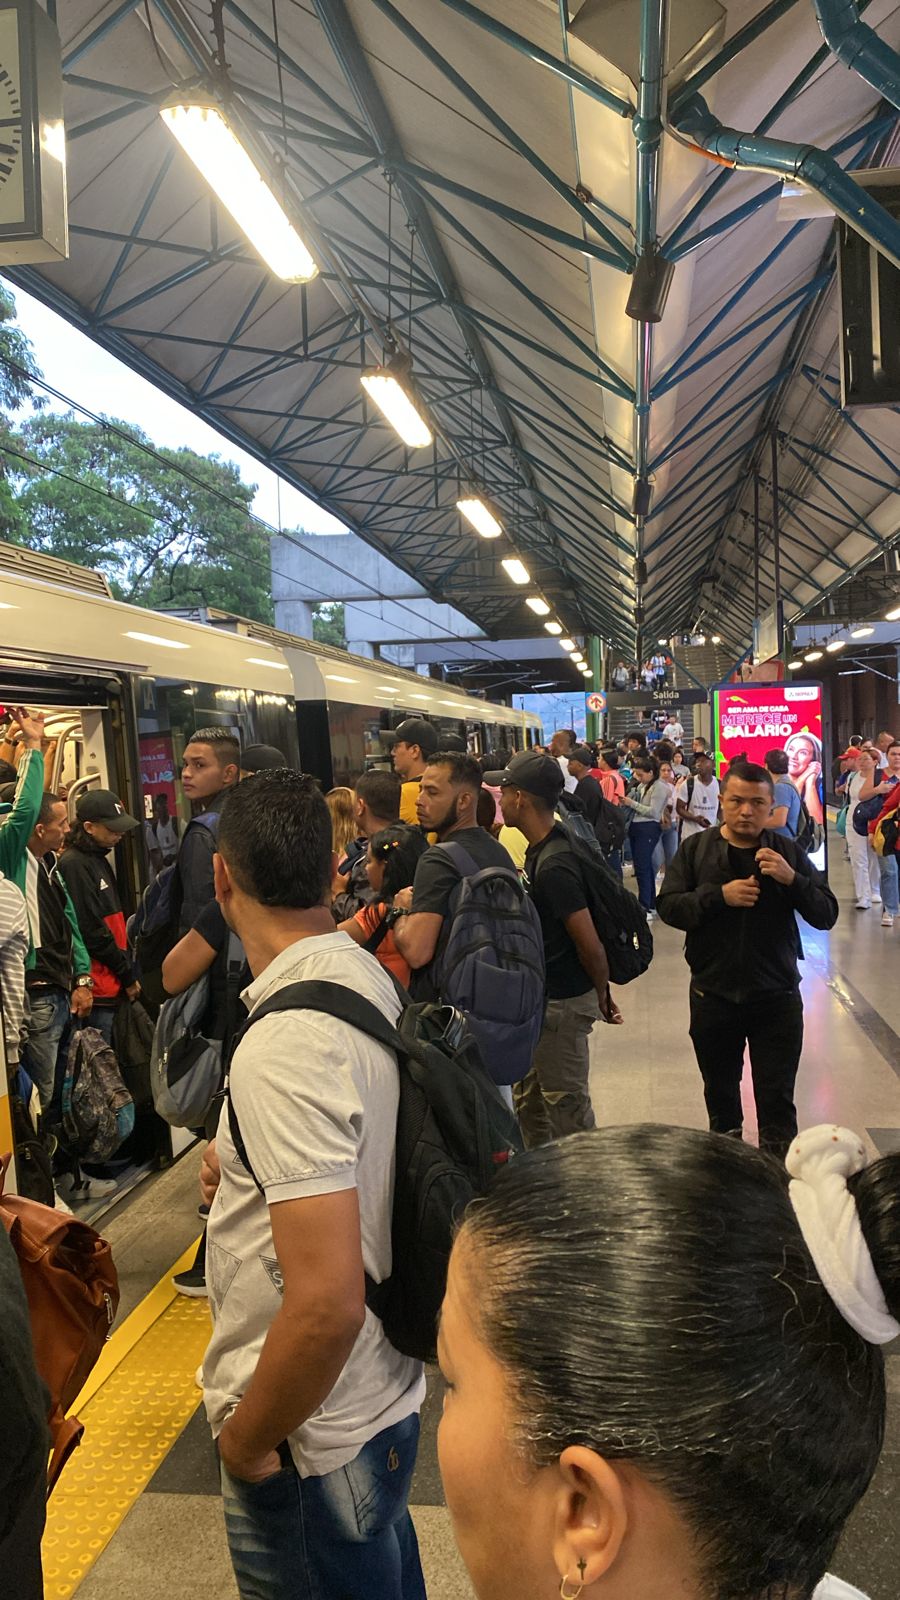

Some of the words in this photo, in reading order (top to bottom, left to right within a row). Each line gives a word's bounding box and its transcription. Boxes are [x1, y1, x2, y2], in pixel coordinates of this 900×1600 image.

[653, 691, 679, 699] Salida
[722, 713, 781, 726] MERECE
[783, 714, 797, 723] UN
[723, 724, 792, 738] SALARIO
